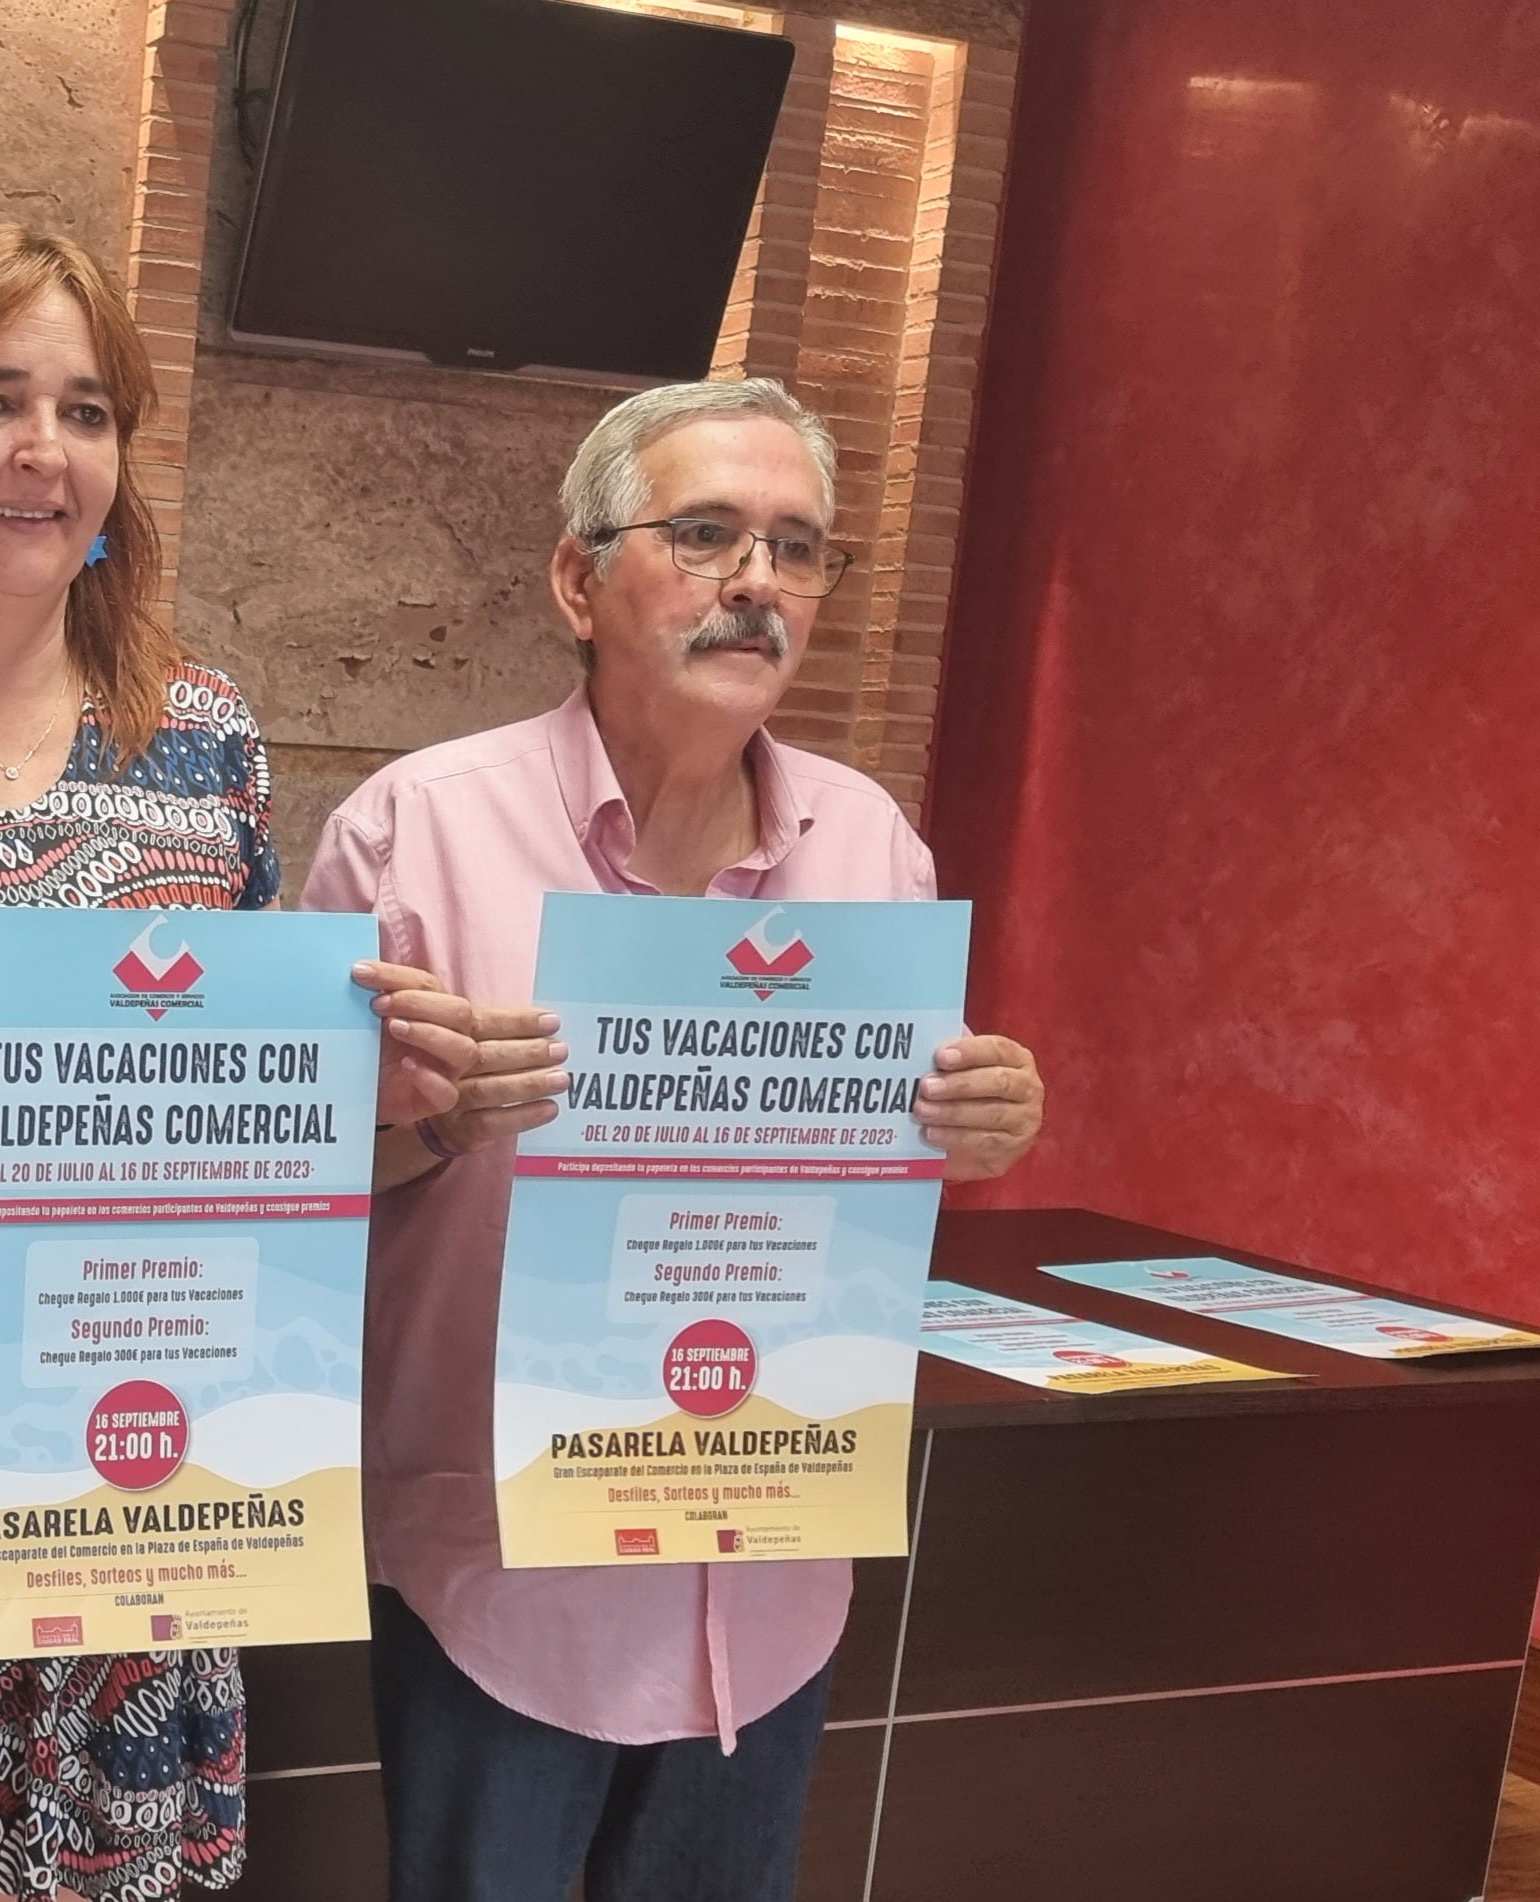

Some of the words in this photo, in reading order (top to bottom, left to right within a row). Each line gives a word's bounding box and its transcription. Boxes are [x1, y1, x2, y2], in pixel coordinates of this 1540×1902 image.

[595, 1015, 653, 1057] TUS
[662, 1017, 848, 1060] VACACIONES
[853, 1021, 915, 1061] CON
[52, 1041, 248, 1085] VACACIONES
[257, 1042, 320, 1085] CON
[565, 1064, 752, 1113] VALDEPEÑAS
[164, 1102, 338, 1146] COMERCIAL
[610, 1123, 632, 1144] 20
[632, 1124, 653, 1144] DE
[652, 1124, 691, 1145] JULIO
[690, 1124, 710, 1145] AL
[711, 1125, 732, 1145] 16
[732, 1125, 753, 1145] DE
[752, 1125, 839, 1146] SEPTIEMBRE
[838, 1126, 859, 1146] DE
[10, 1161, 32, 1184] 20
[34, 1161, 54, 1183] DE
[55, 1161, 95, 1183] JULIO
[97, 1161, 117, 1183] AL
[119, 1160, 138, 1183] 16
[140, 1160, 161, 1182] DE
[161, 1159, 251, 1182] SEPTIEMBRE
[252, 1158, 272, 1181] DE
[668, 1209, 722, 1231] Primer
[722, 1210, 784, 1232] Premio:
[81, 1256, 138, 1282] Primer
[140, 1255, 204, 1281] Premio:
[652, 1262, 722, 1288] Segundo
[723, 1260, 784, 1283] Premio:
[37, 1291, 76, 1310] Cheque
[75, 1290, 112, 1309] Regalo
[145, 1290, 170, 1307] para
[169, 1288, 187, 1303] tus
[187, 1286, 245, 1303] Vacaciones
[70, 1316, 144, 1346] Segundo
[146, 1312, 210, 1339] Premio:
[670, 1346, 685, 1363] 16
[685, 1346, 751, 1363] SEPTIEMBRE
[668, 1364, 725, 1392] 21:00
[727, 1364, 748, 1391] h.
[94, 1412, 110, 1431] 16
[110, 1409, 181, 1430] SEPTIEMBRE
[93, 1430, 154, 1463] 21:00
[158, 1430, 180, 1460] h.
[550, 1430, 687, 1461] PASARELA
[692, 1422, 858, 1458] VALDEPEÑAS
[606, 1484, 662, 1505] Desfiles,
[662, 1485, 710, 1503] Sorteos
[710, 1486, 721, 1506] y
[721, 1483, 764, 1501] mucho
[121, 1491, 305, 1535] VALDEPEÑAS
[25, 1567, 88, 1590] Desfiles,
[89, 1566, 143, 1586] Sorteos
[144, 1566, 156, 1589] y
[156, 1562, 204, 1583] mucho
[113, 1591, 166, 1608] COLABORAN
[183, 1617, 250, 1632] Valdepeñas
